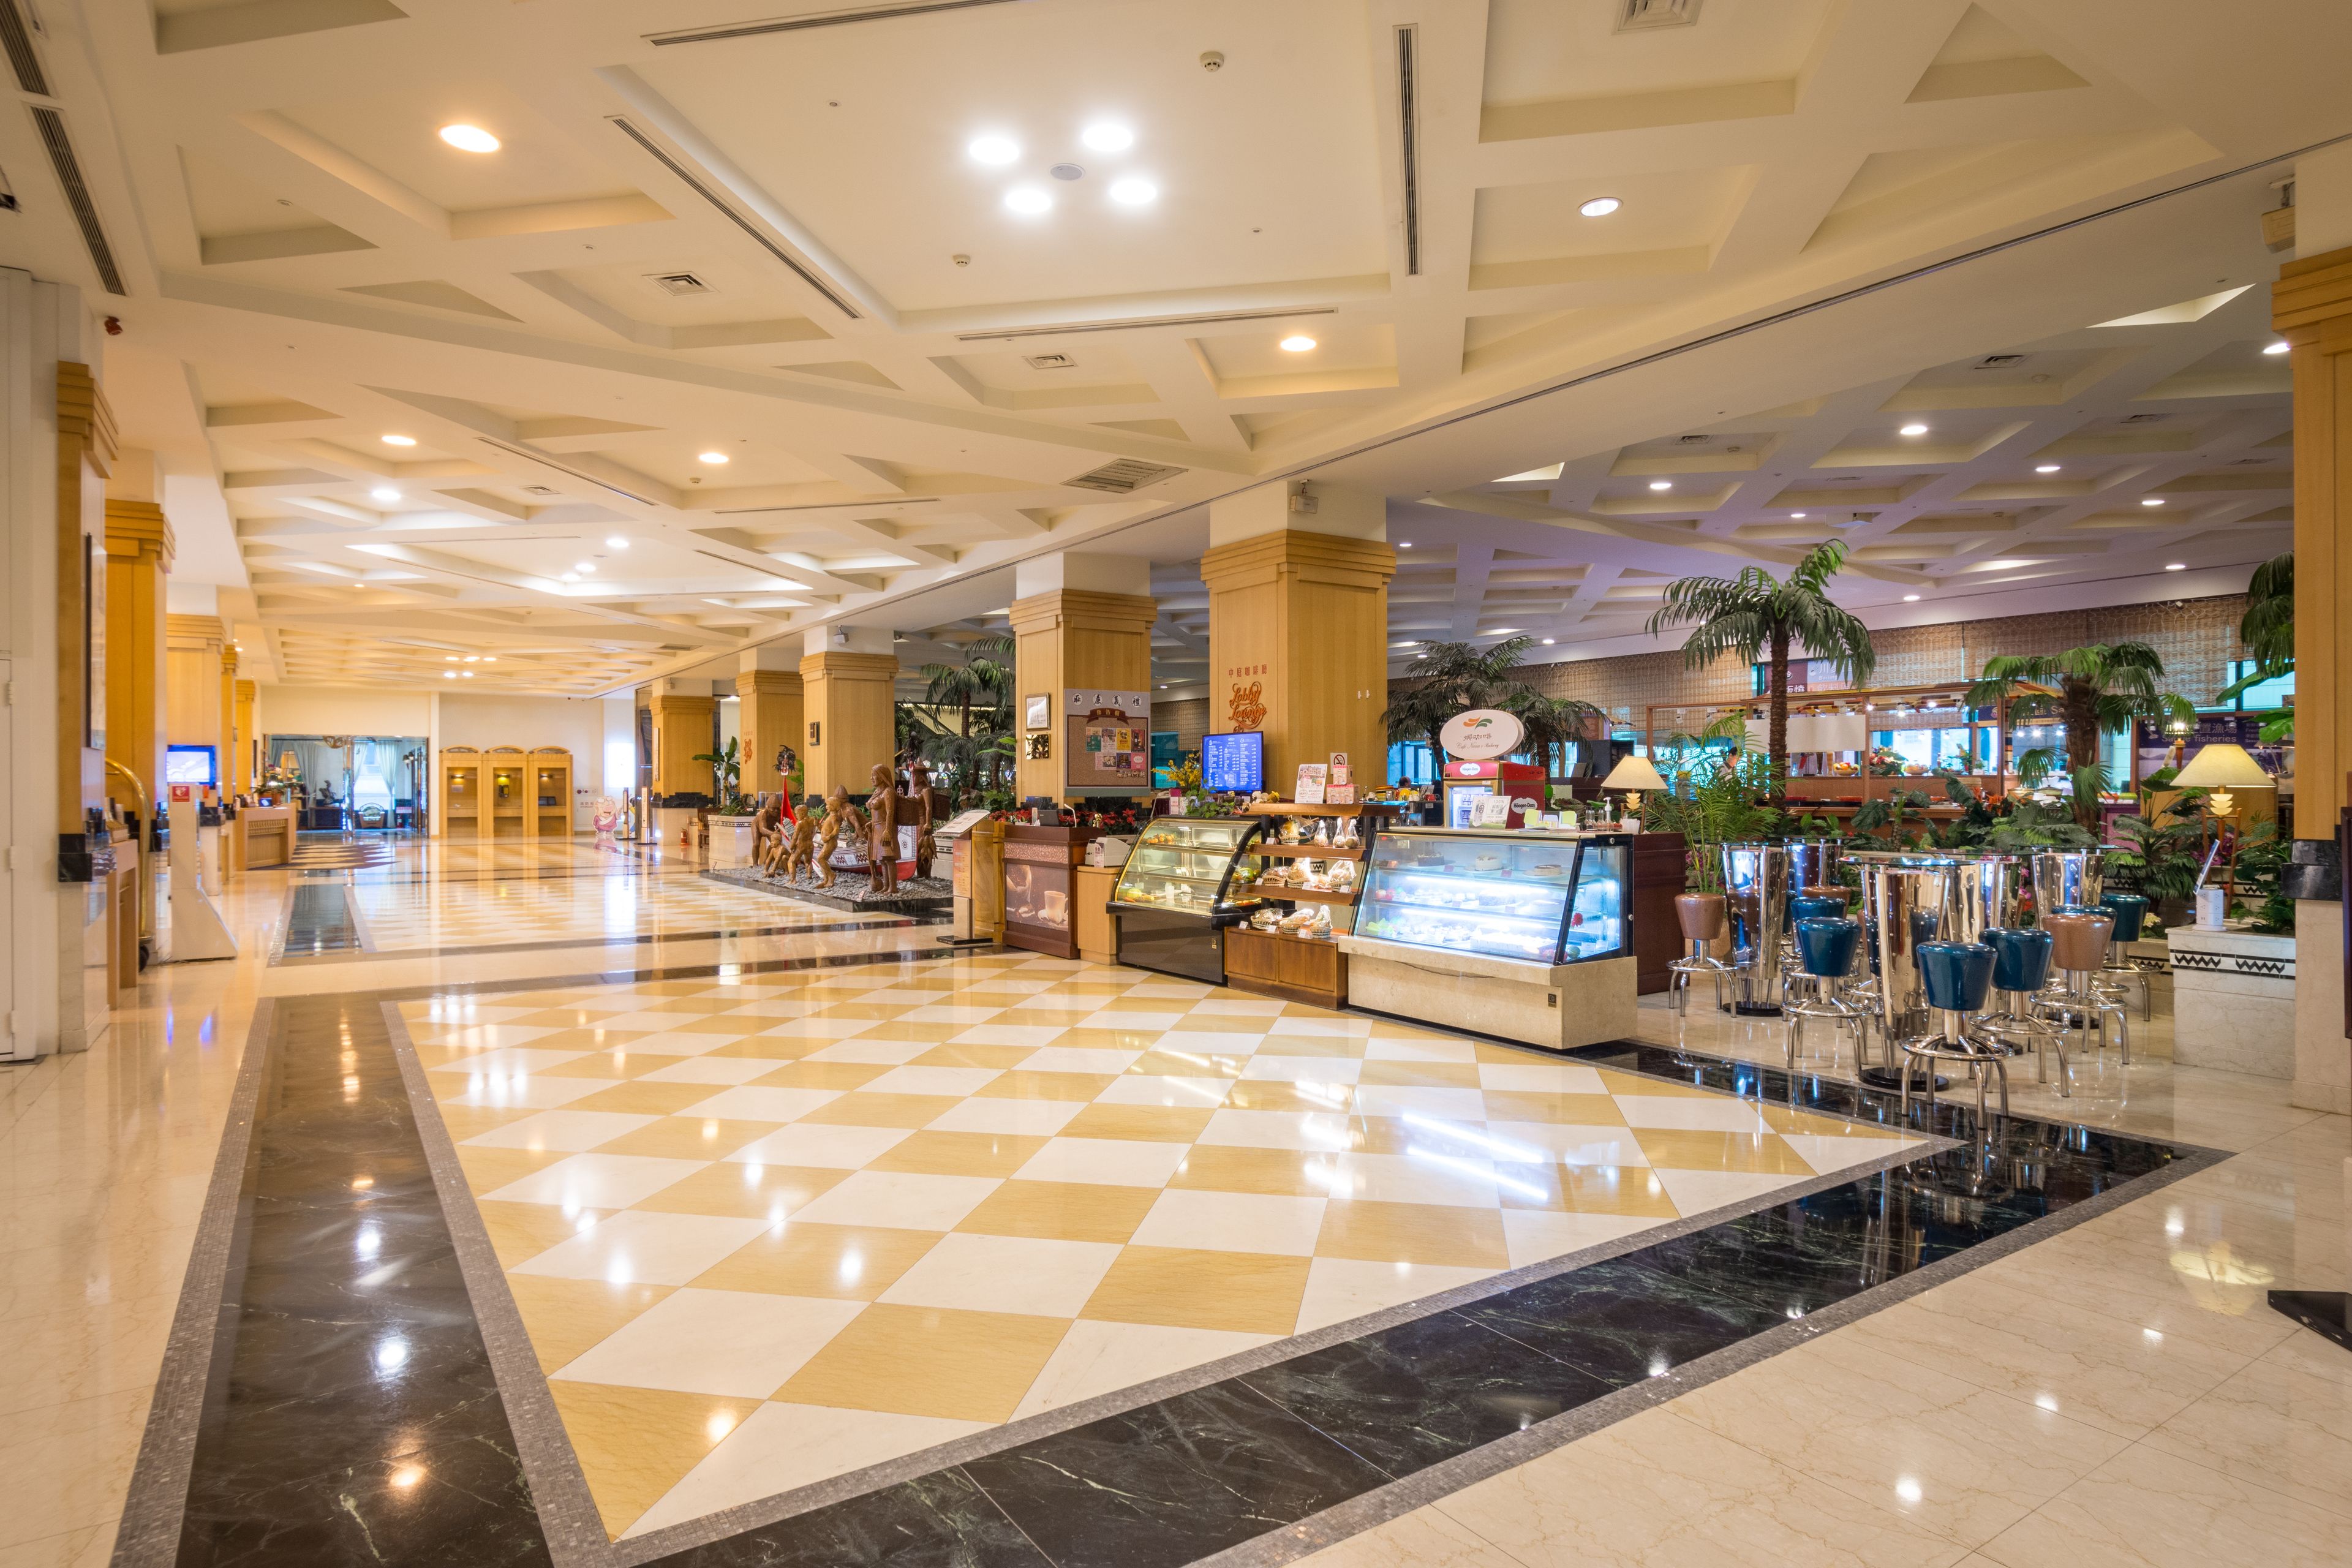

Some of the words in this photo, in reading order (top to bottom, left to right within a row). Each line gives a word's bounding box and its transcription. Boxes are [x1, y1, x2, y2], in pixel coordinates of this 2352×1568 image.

[1229, 681, 1262, 706] Lobby
[1228, 704, 1267, 729] Lounge
[2051, 706, 2064, 714] Sa
[2195, 723, 2237, 734] 置漁場
